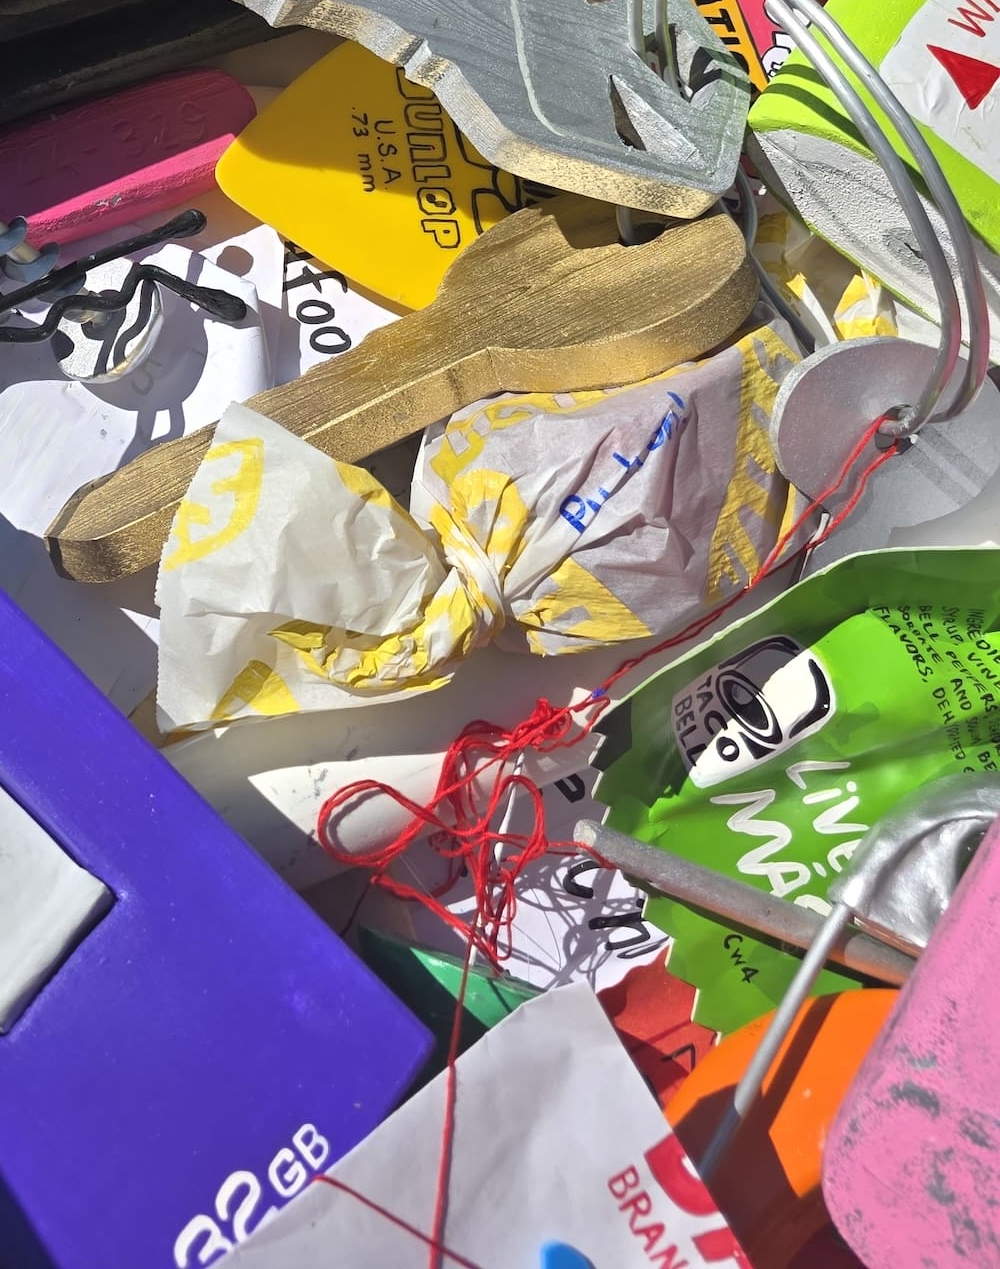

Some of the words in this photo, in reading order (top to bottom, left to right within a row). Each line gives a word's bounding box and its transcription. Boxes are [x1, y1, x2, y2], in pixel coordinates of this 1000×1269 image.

[356, 152, 378, 193] mm
[373, 118, 404, 192] U.S.A.
[872, 605, 934, 683] FLAVORS,
[896, 604, 945, 664] SORBATE
[950, 677, 973, 711] AND
[917, 604, 940, 643] BELL
[674, 694, 708, 767] BELL
[696, 674, 740, 763] TACO
